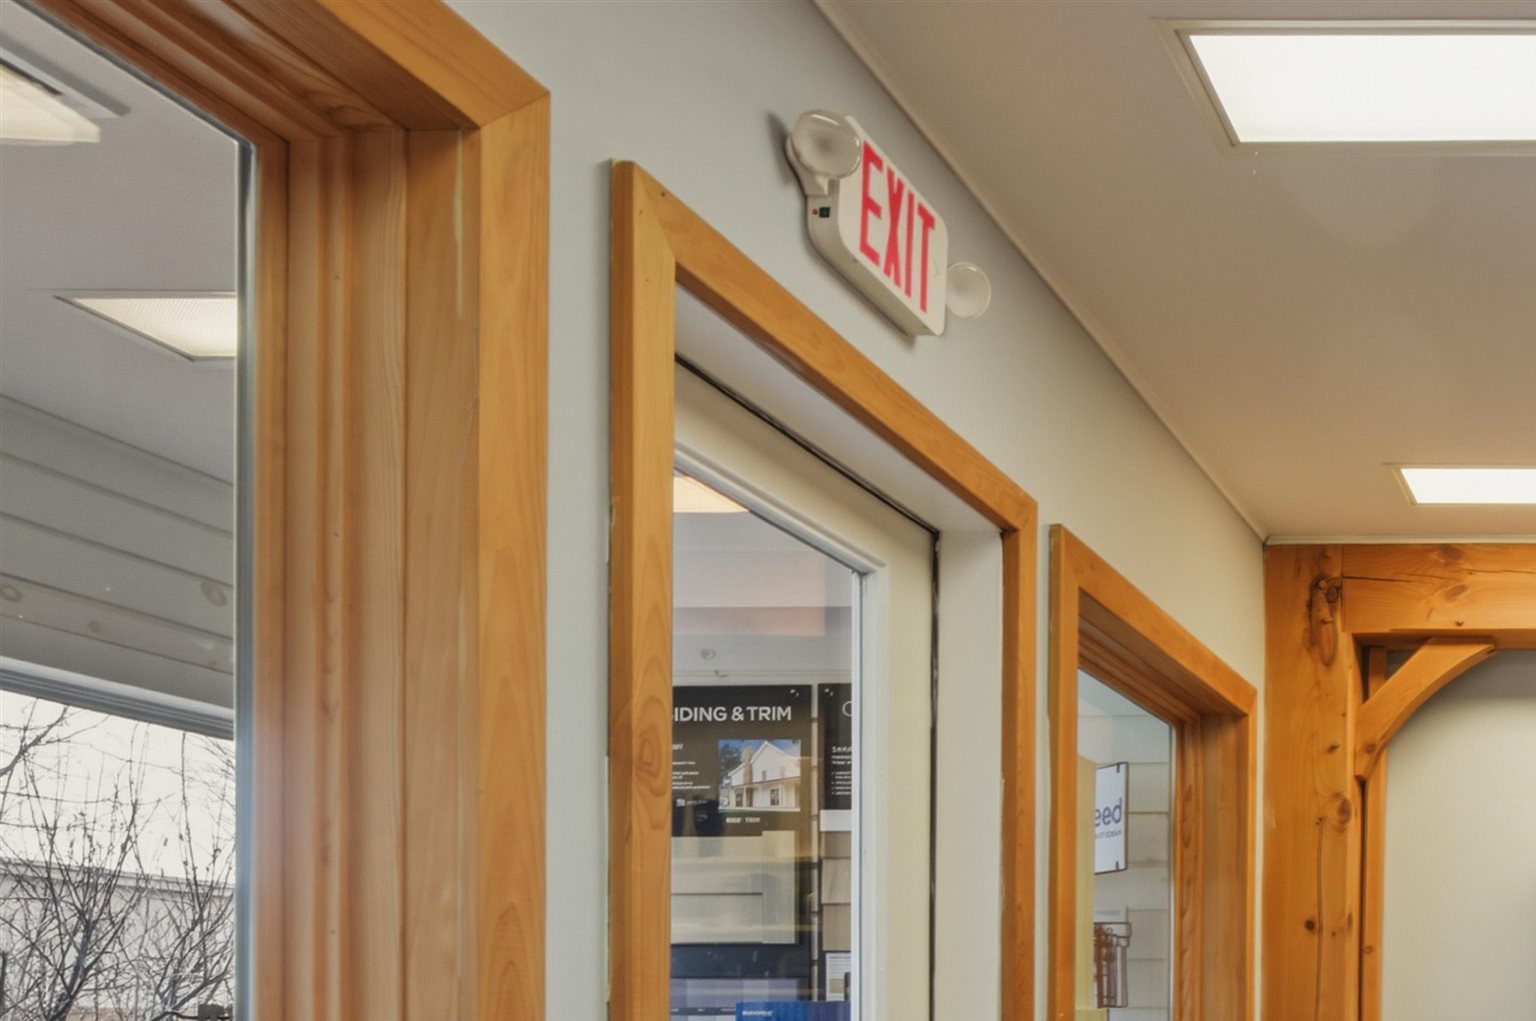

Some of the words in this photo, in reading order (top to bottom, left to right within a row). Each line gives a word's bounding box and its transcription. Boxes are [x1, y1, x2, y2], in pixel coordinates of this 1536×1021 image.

[859, 140, 936, 314] EXIT
[672, 706, 727, 721] IDING
[731, 706, 744, 721] &
[745, 705, 792, 721] TRIM
